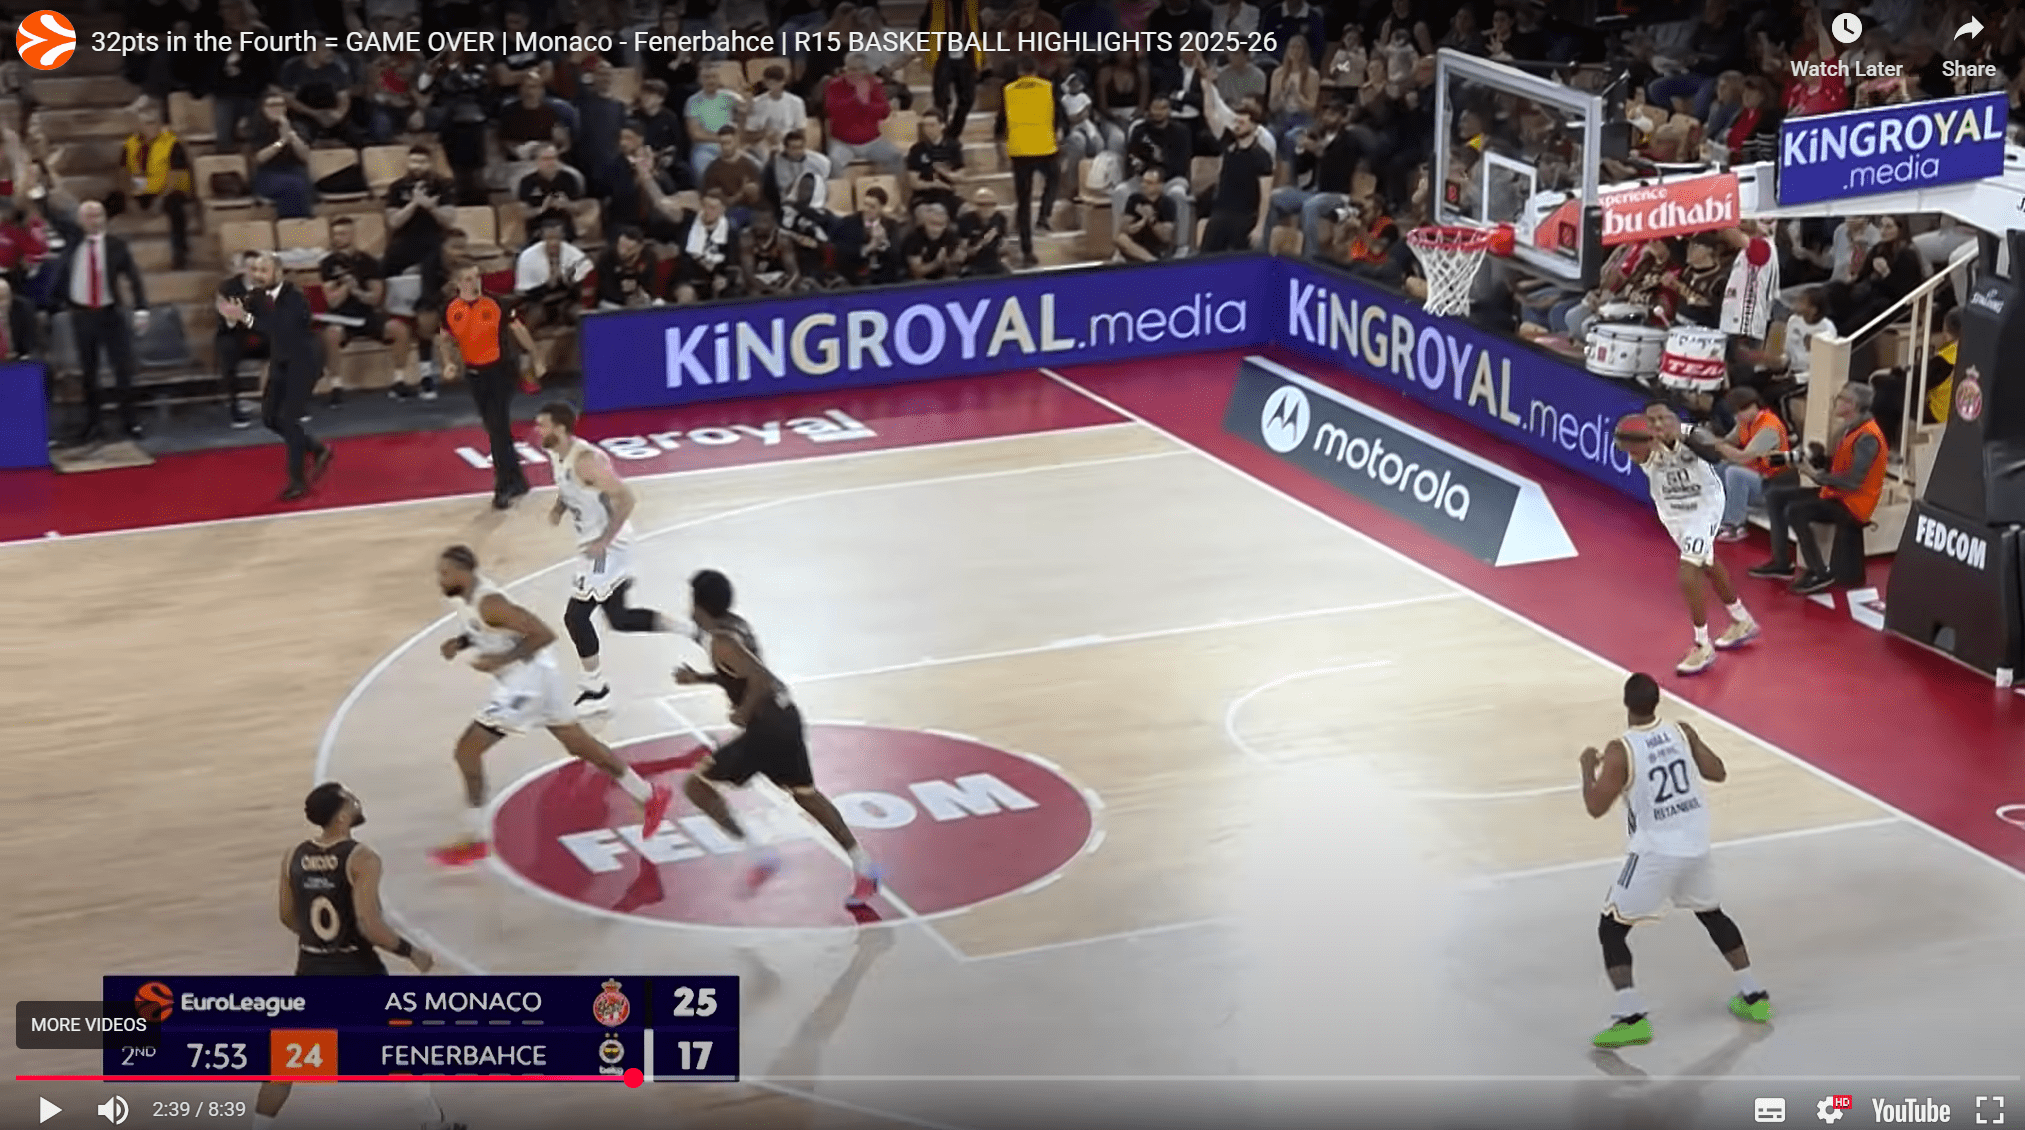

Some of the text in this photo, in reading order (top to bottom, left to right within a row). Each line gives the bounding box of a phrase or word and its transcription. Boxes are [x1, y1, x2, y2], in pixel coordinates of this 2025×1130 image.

[1843, 154, 1940, 190] .media
[1598, 187, 1668, 210] xperience
[1602, 192, 1734, 237] bu dhabi
[1313, 421, 1471, 522] motorola
[1915, 513, 1987, 571] FEDCOM
[1648, 757, 1690, 804] 20
[558, 773, 1040, 874] FEOM
[310, 895, 340, 942] 0
